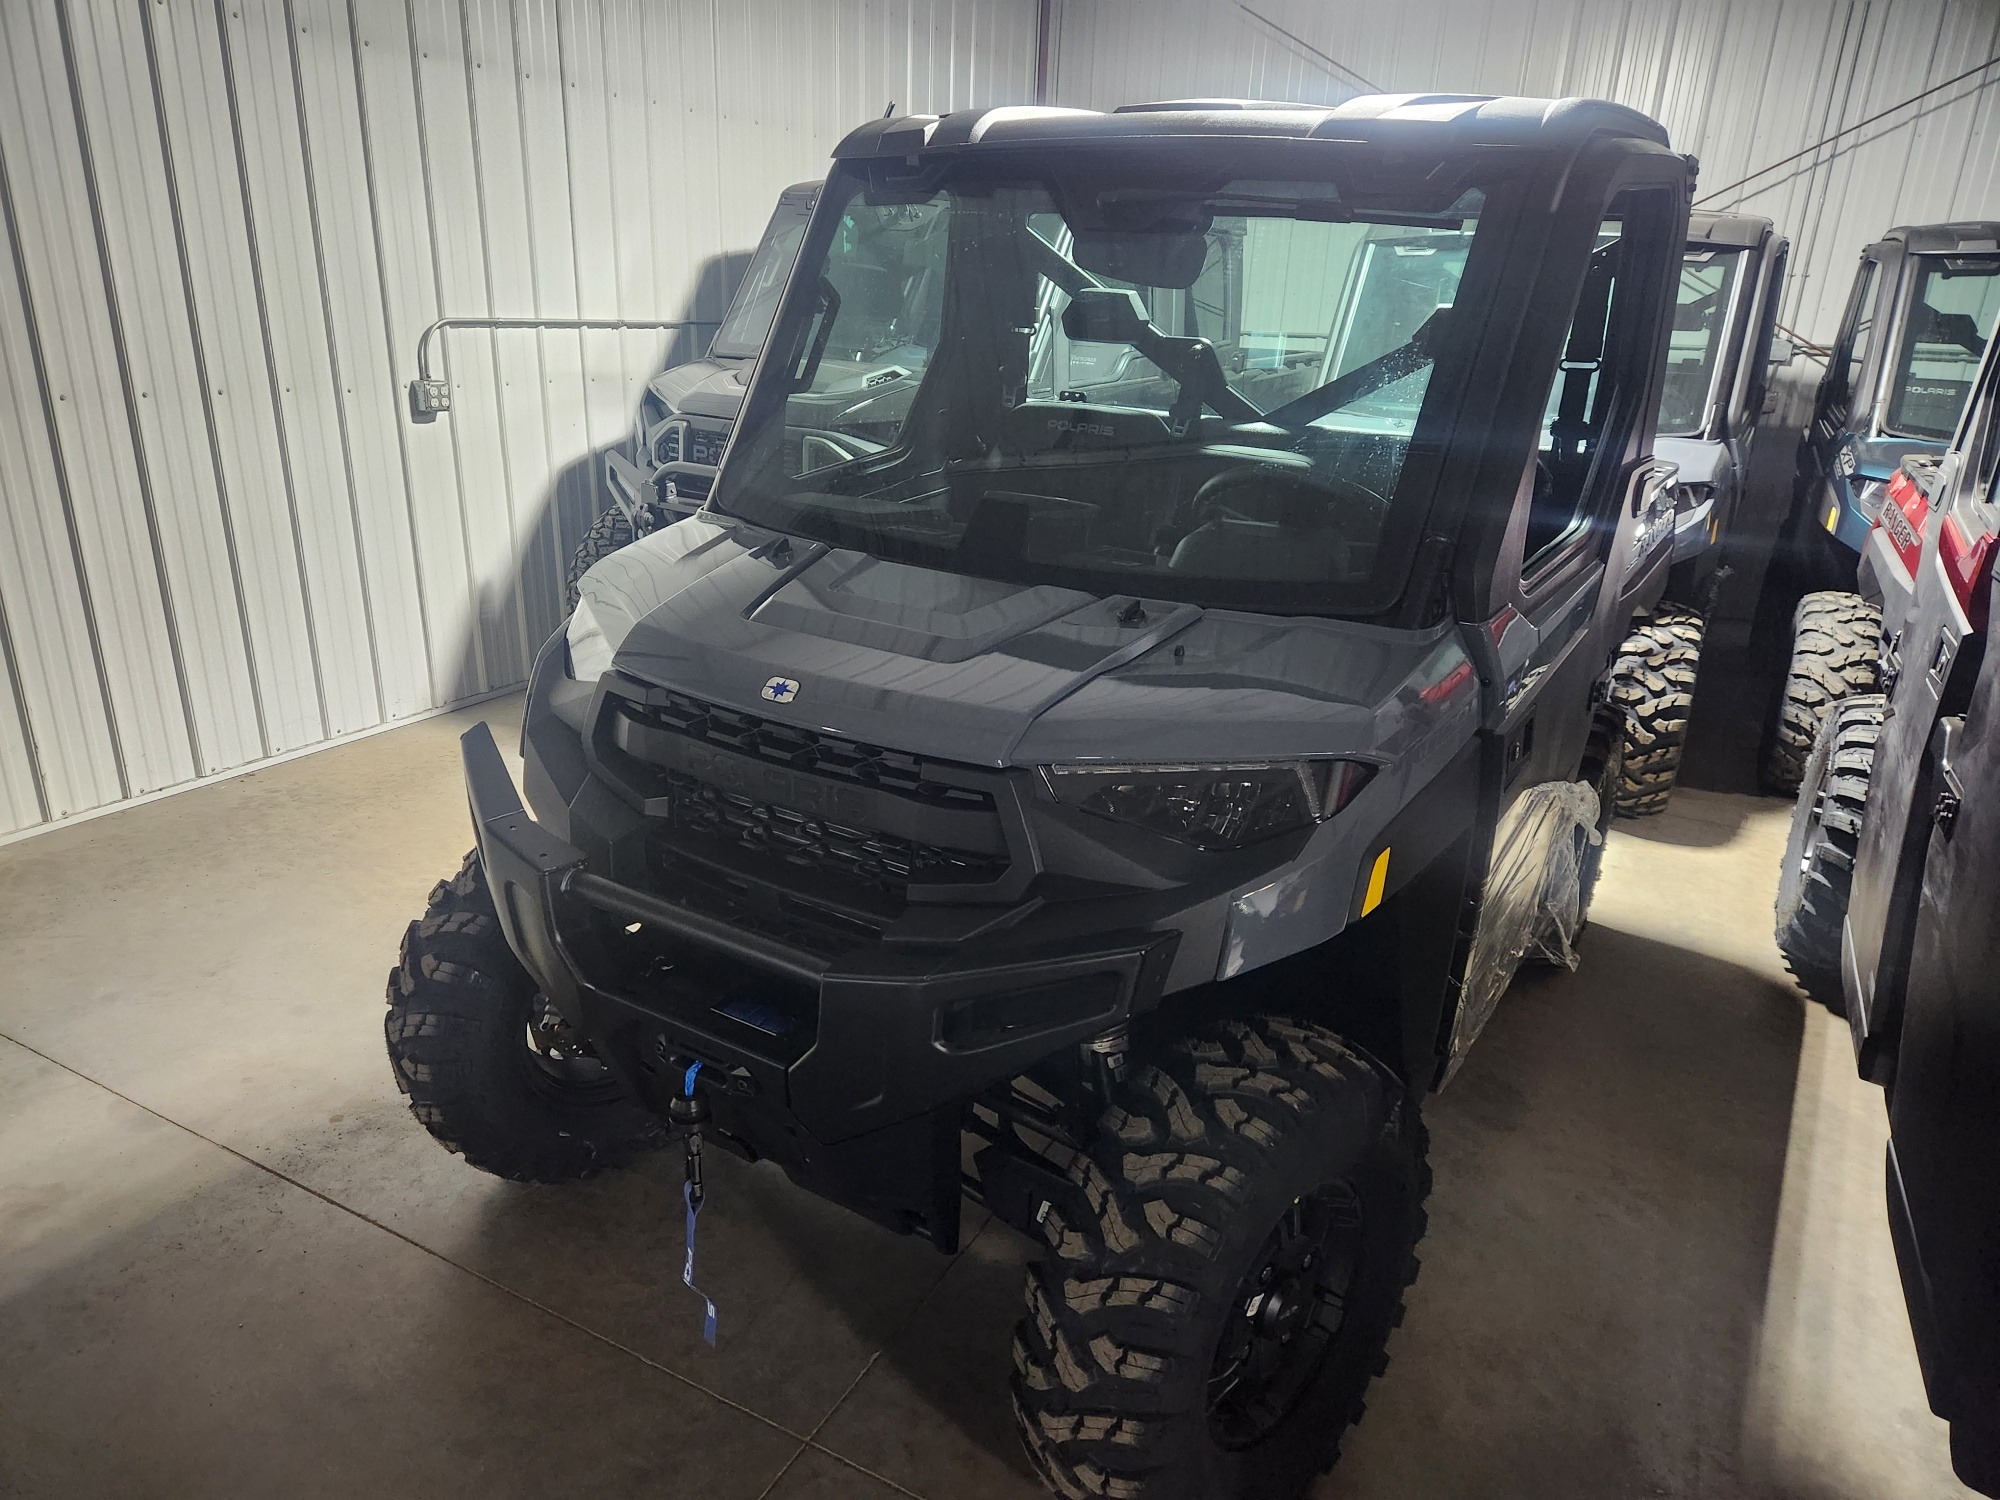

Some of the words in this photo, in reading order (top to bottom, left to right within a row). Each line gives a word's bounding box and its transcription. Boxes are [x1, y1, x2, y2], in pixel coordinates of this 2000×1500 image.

[1047, 419, 1115, 436] POLARIS
[1841, 452, 1854, 468] XP
[1882, 501, 1912, 551] RANGER
